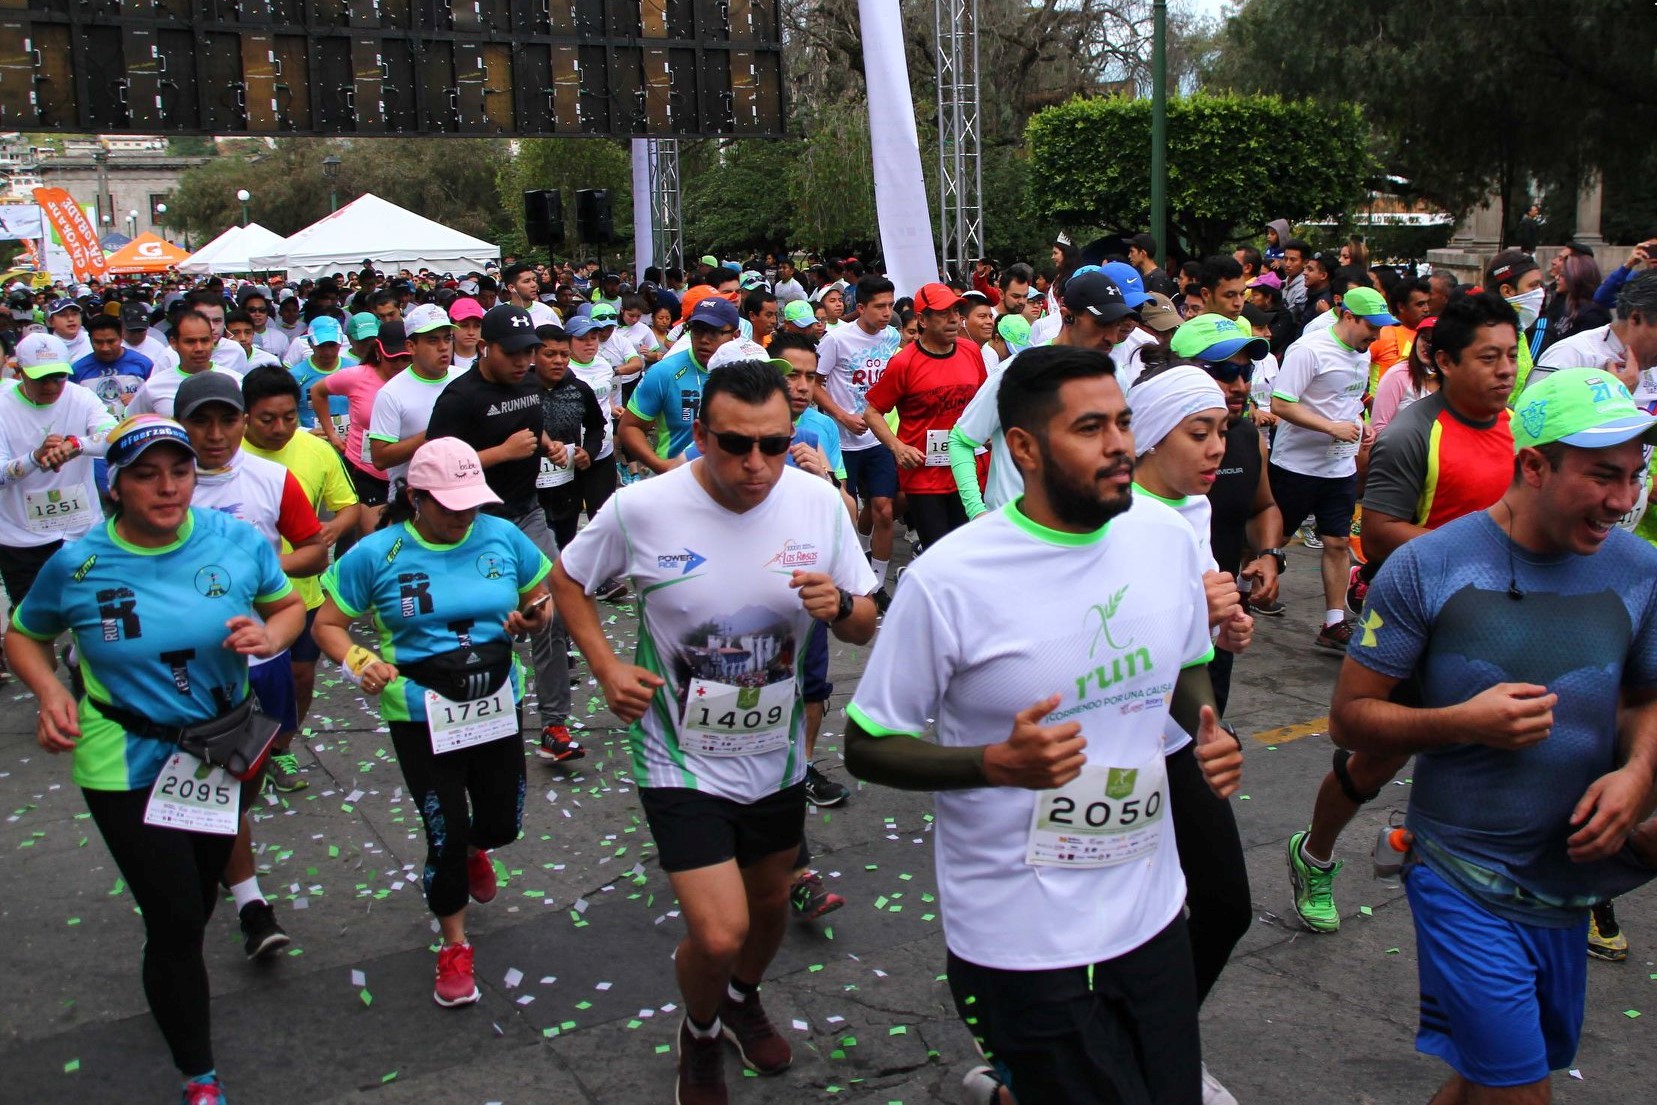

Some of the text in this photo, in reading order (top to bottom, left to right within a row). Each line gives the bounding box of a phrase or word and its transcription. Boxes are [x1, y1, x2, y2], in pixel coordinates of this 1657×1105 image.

[866, 359, 881, 368] GO
[501, 394, 540, 414] RUNNING
[459, 459, 477, 470] babe
[36, 499, 80, 516] 1251
[657, 554, 696, 562] POWER
[401, 596, 415, 618] RUN
[102, 617, 119, 642] RUN
[1075, 647, 1153, 700] run
[1103, 695, 1123, 707] POR
[1123, 689, 1145, 701] UNA
[444, 697, 503, 724] 1721
[698, 706, 782, 729] 1409
[162, 776, 231, 805] 2095
[1049, 791, 1161, 827] 2050
